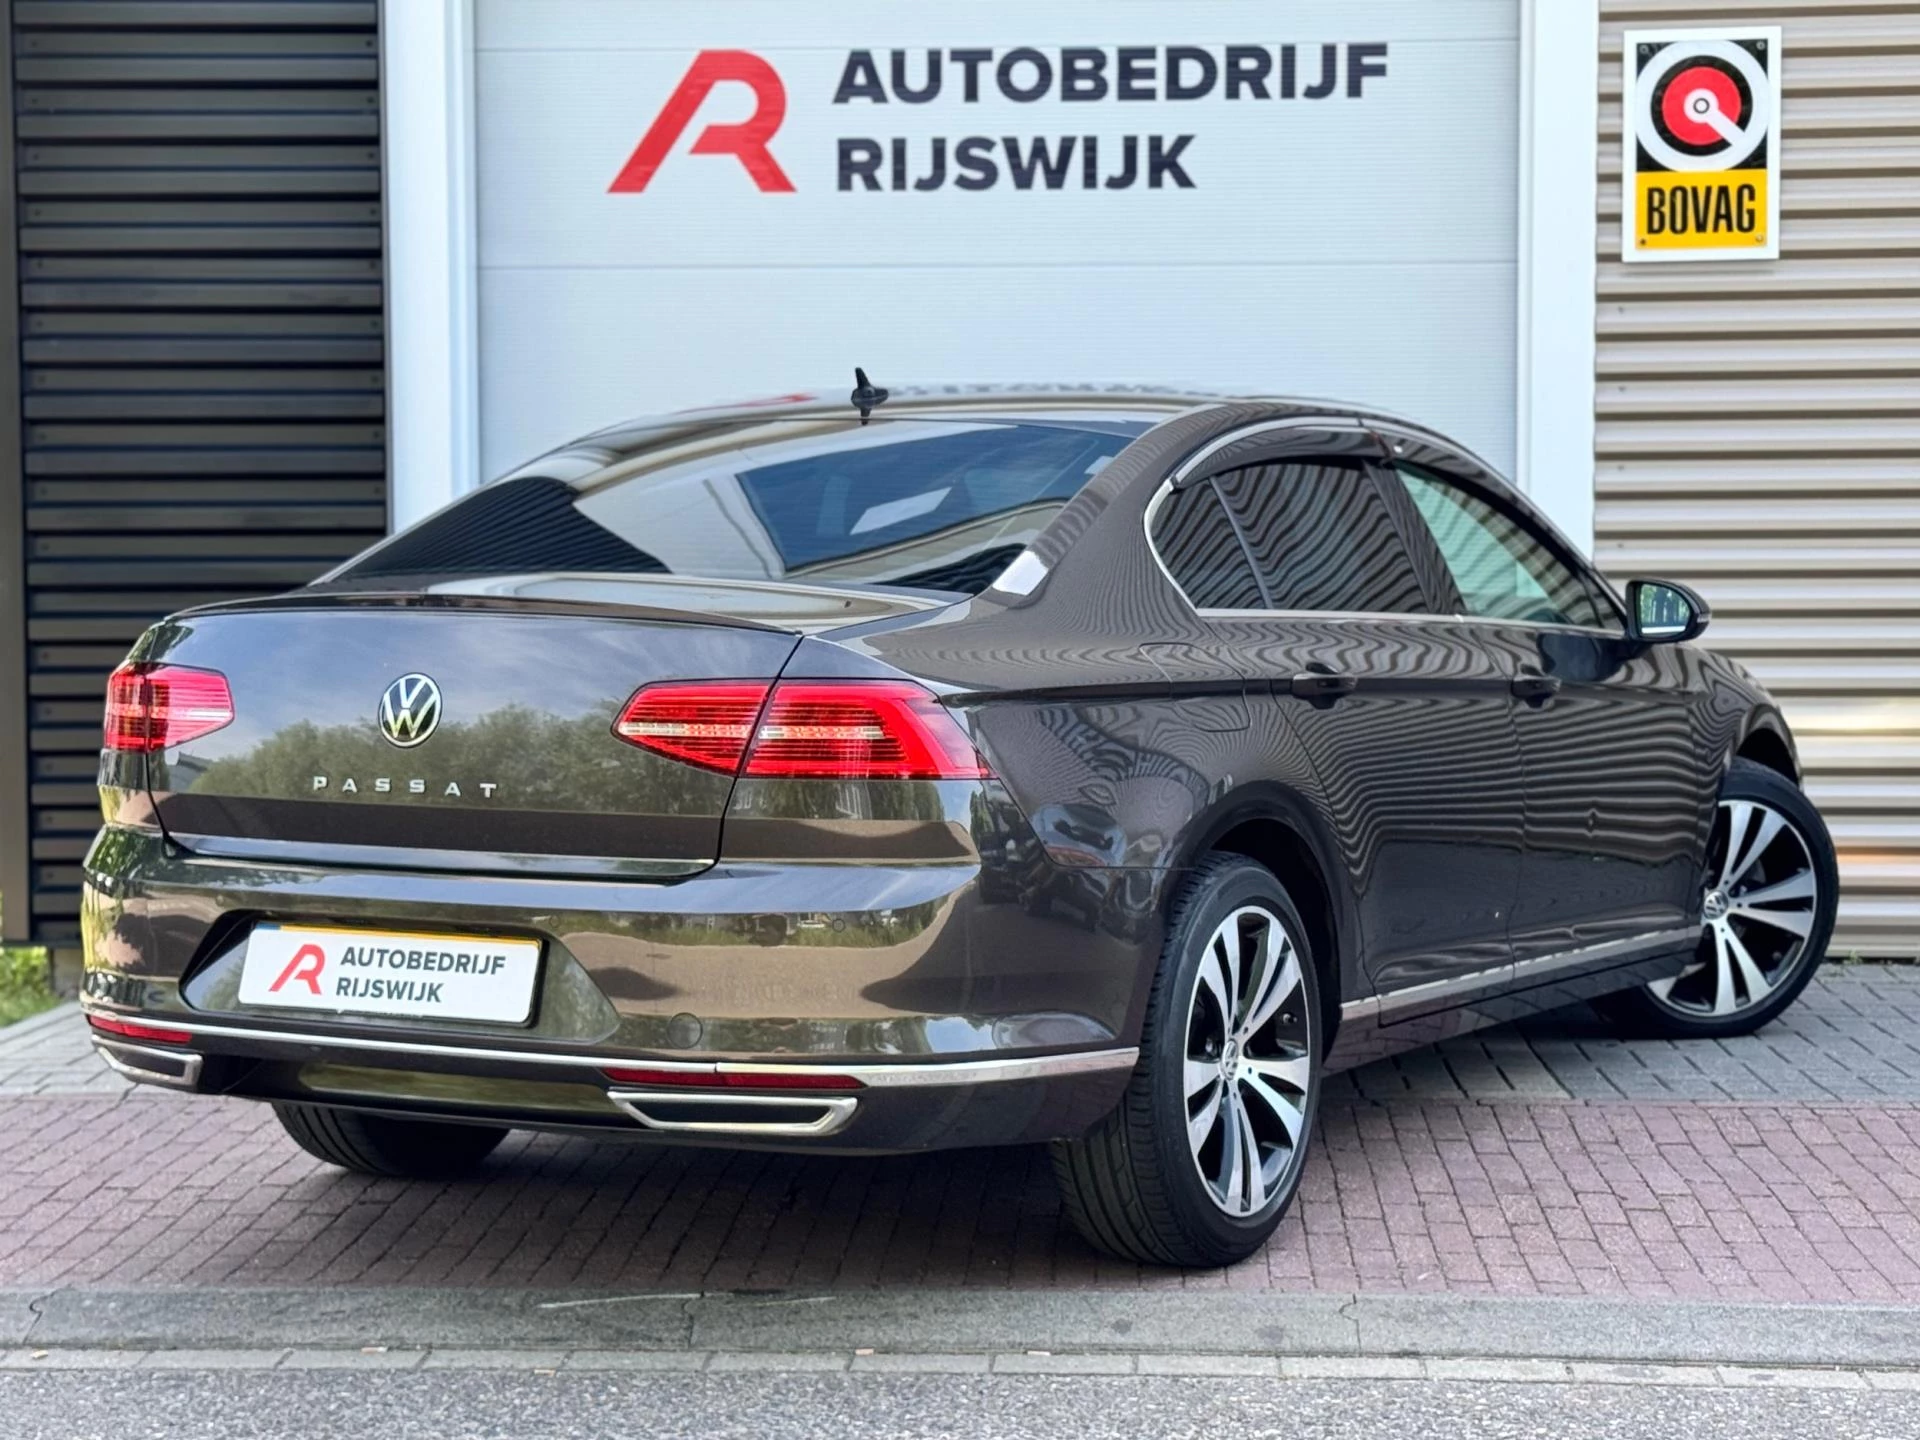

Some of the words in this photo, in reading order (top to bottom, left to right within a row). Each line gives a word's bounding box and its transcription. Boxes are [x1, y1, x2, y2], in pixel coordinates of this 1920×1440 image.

[833, 43, 1388, 104] AUTOBEDRIJF
[837, 135, 1196, 191] RIJSWIJK
[1647, 184, 1756, 235] BOVAG
[313, 776, 497, 798] PASSAT
[340, 946, 506, 976] AUTOBEDRIJF
[335, 977, 444, 1003] RIJSWIJK
